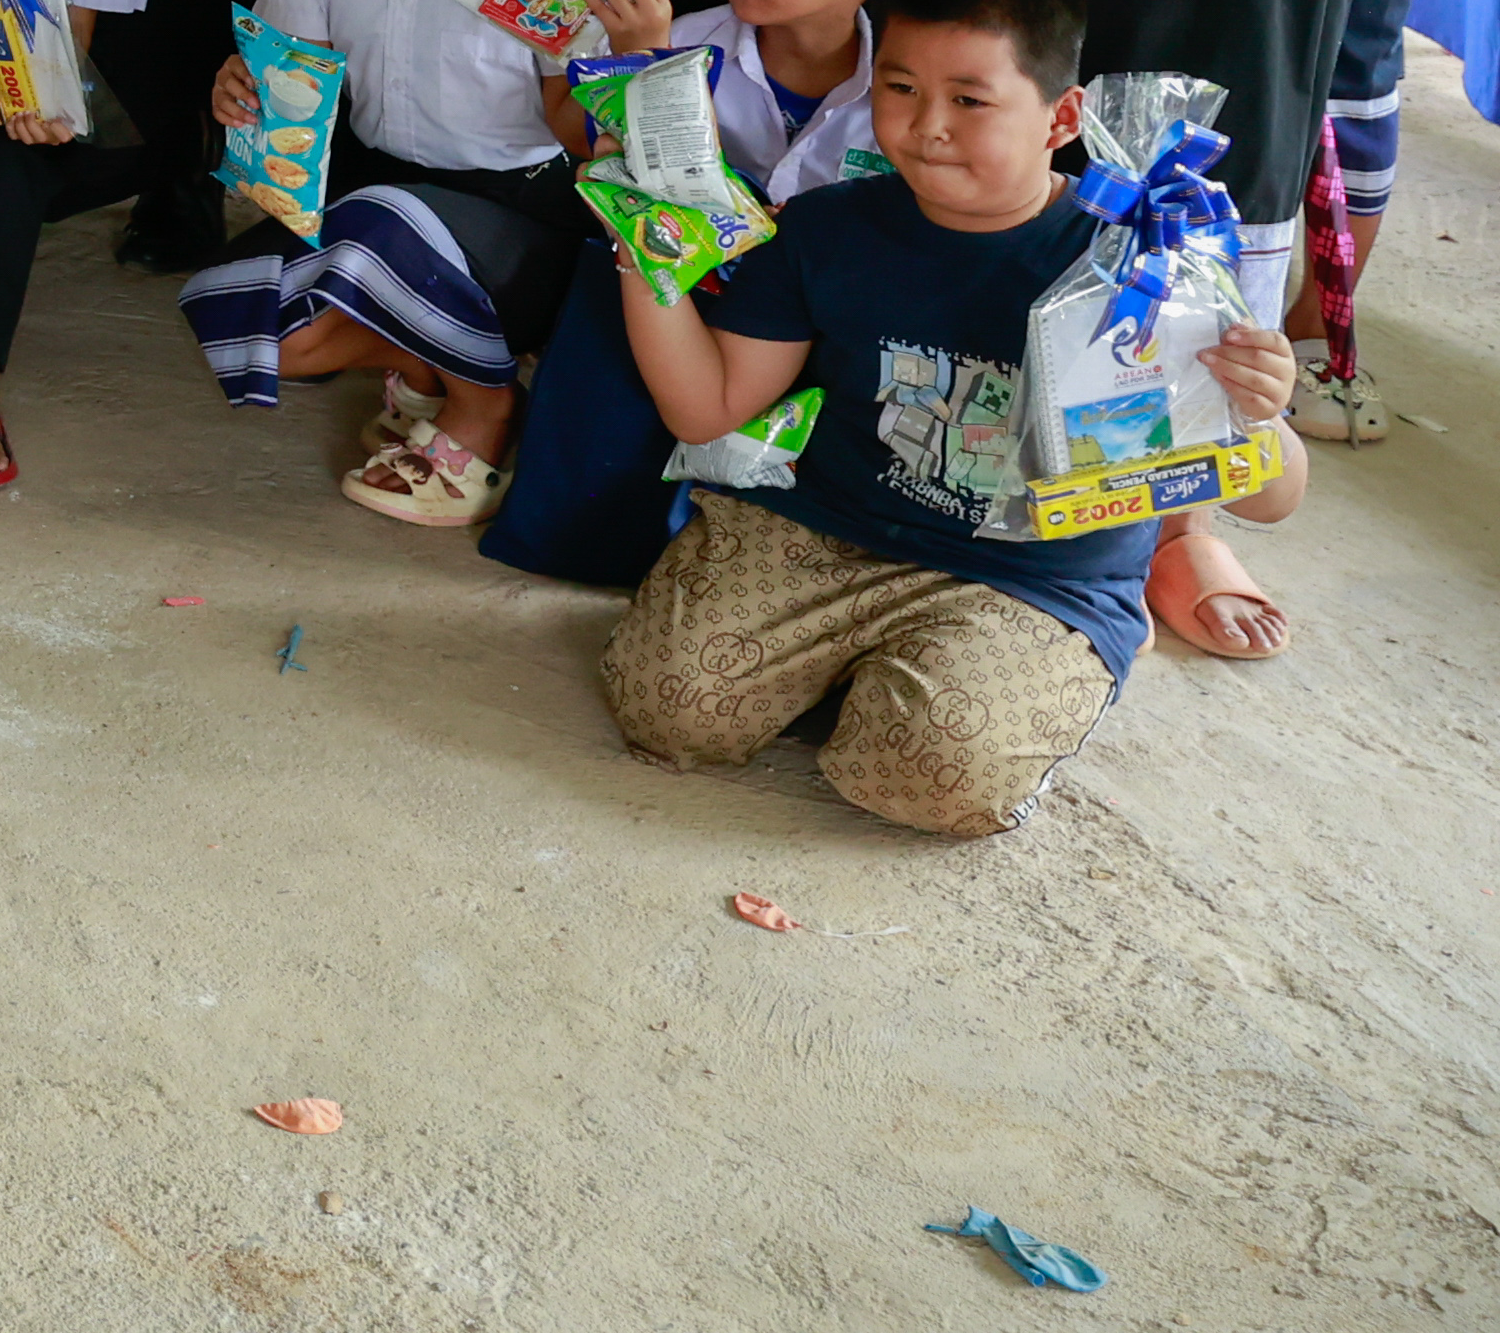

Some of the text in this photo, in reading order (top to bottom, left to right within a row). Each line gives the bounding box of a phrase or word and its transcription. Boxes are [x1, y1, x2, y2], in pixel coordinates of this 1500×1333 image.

[1108, 461, 1209, 490] BLACKLEAD PENCIL
[1160, 473, 1208, 502] elfen
[1072, 496, 1144, 525] 2002
[657, 673, 746, 718] GUCCI
[885, 722, 968, 793] GUCCI
